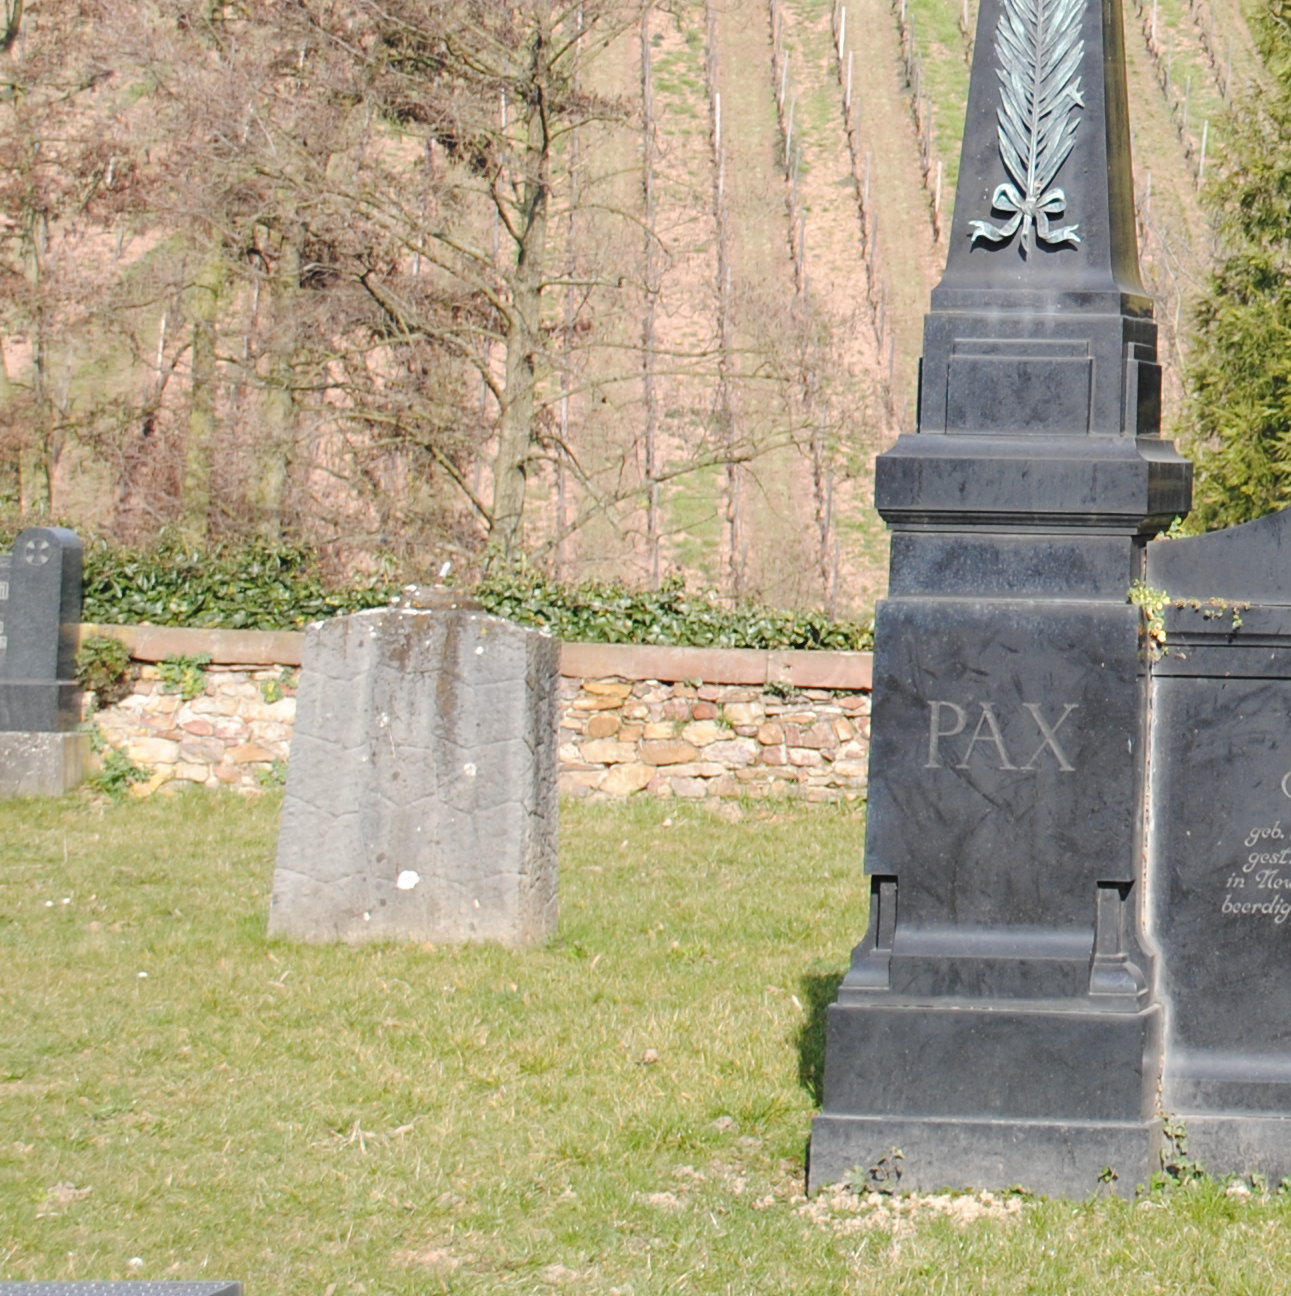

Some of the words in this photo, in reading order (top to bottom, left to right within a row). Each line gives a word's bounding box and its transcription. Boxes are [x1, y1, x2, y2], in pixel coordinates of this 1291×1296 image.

[923, 700, 1080, 772] PAX
[1244, 820, 1285, 847] geb.
[1226, 872, 1246, 889] in
